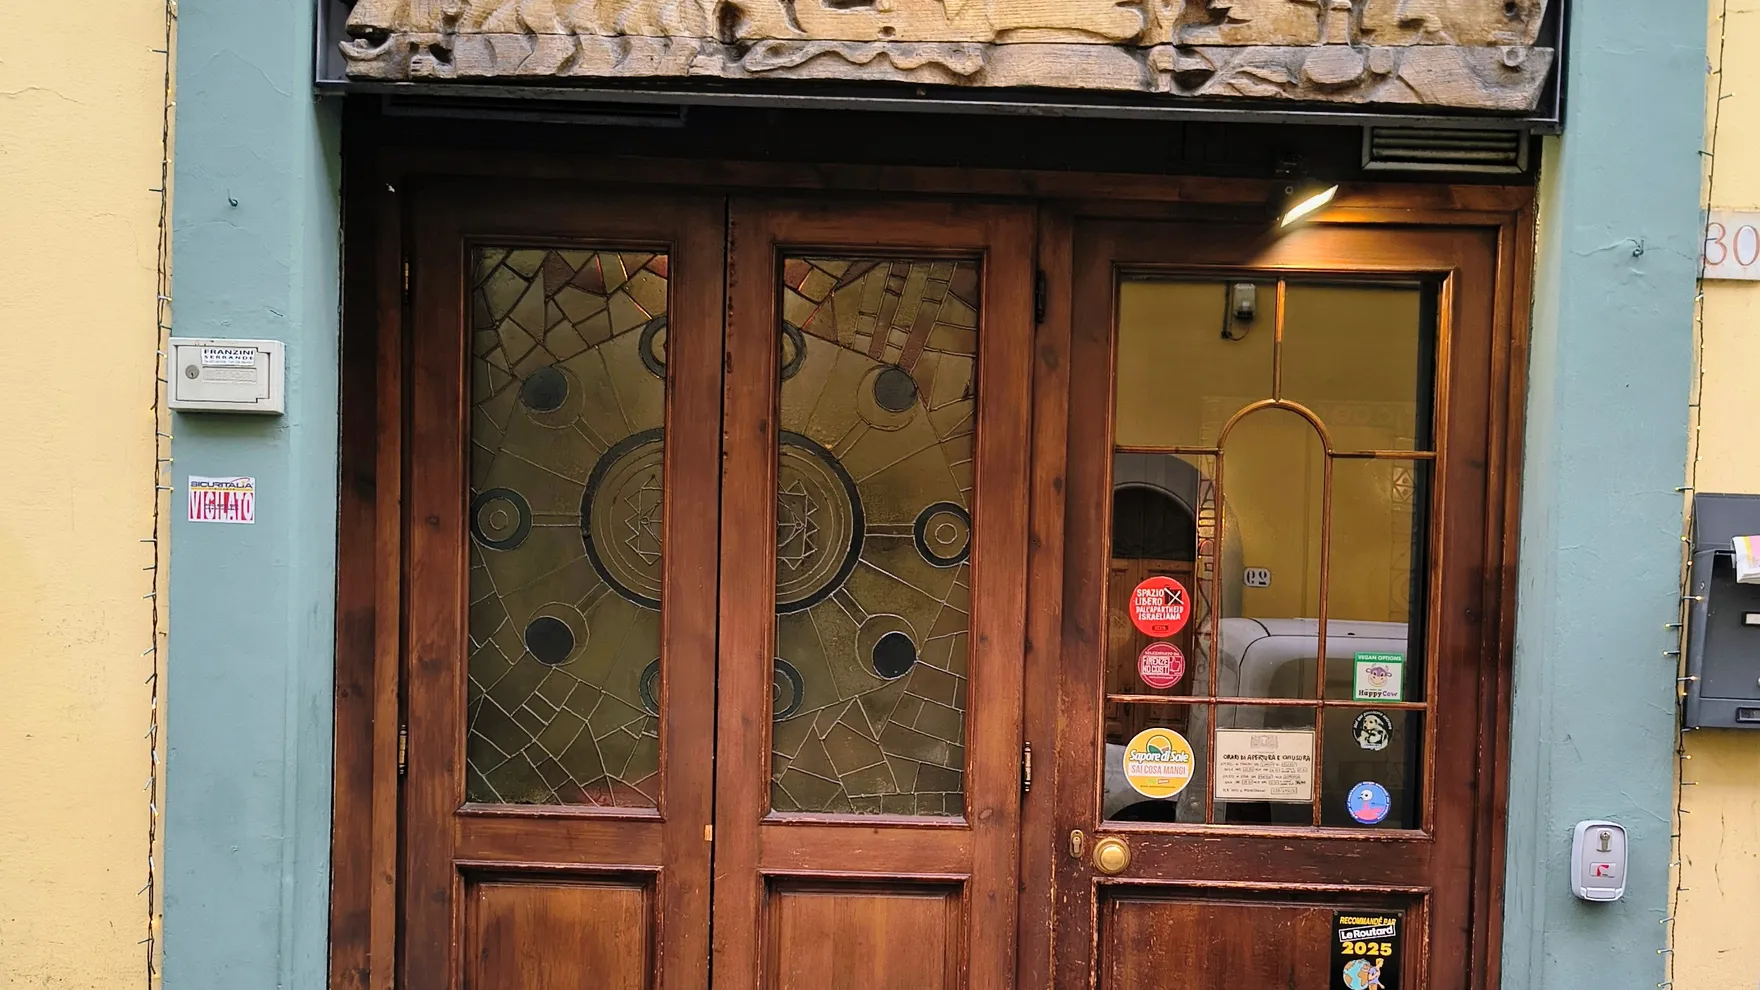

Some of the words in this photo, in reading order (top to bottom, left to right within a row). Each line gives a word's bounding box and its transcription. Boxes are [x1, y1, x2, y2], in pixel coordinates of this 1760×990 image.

[1703, 221, 1760, 267] 30
[190, 491, 253, 521] VIGILATO
[1136, 588, 1165, 597] SPAZIO
[1135, 597, 1163, 606] LIBERO
[1135, 605, 1184, 614] DALL'APARTHEID
[1138, 613, 1181, 621] ISRAELIANA
[1142, 656, 1169, 665] FIRENZE
[1129, 749, 1160, 764] Sapore
[1160, 750, 1170, 762] di
[1170, 750, 1189, 763] Sole
[1131, 764, 1143, 774] SAI
[1143, 765, 1162, 774] COSA
[1163, 766, 1186, 775] MANGI
[1340, 916, 1383, 925] RECOMMANDÉ
[1383, 918, 1397, 926] PAR
[1341, 931, 1353, 940] Le
[1353, 926, 1393, 938] Routard
[1341, 941, 1393, 956] 2025
